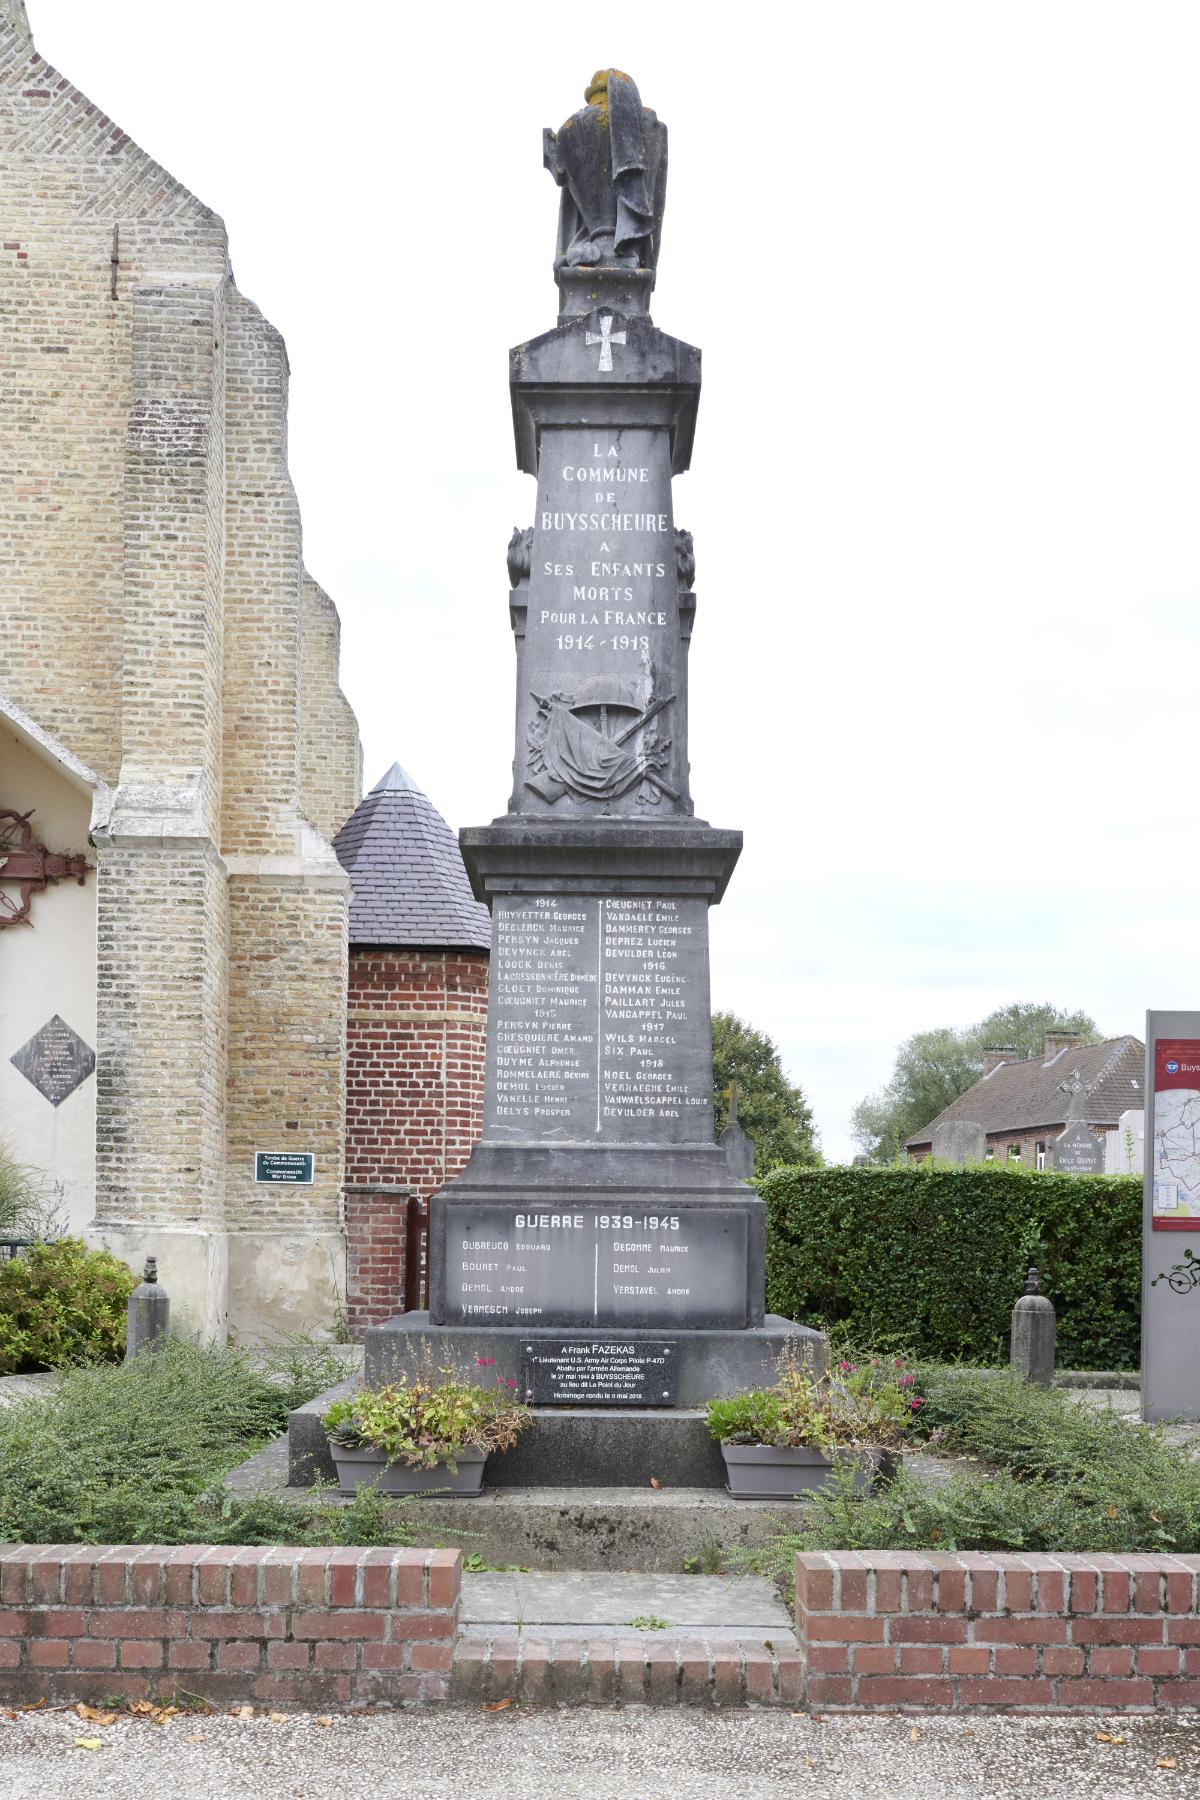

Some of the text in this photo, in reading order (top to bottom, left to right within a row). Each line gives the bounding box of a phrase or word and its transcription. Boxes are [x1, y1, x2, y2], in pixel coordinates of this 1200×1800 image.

[593, 443, 618, 457] LA
[562, 466, 649, 482] COMMUNE
[595, 493, 615, 502] DE
[541, 512, 668, 532] BUYSSCHEURE
[600, 542, 610, 551] A
[544, 562, 665, 577] SES ENFANTS
[573, 586, 633, 601] MORTS
[541, 610, 666, 625] POUR LA FRANCE
[556, 635, 595, 650] 1914
[611, 635, 649, 650] 1918
[535, 899, 557, 907] 1914
[656, 901, 676, 909] PAUL
[554, 912, 587, 920] GEORGES
[606, 912, 653, 921] VANDAELE
[499, 922, 585, 932] DECLERCK MAURICE
[606, 924, 692, 934] DAMMEREY GEORGES
[499, 935, 579, 945] PERSYN JACQUES
[606, 937, 676, 946] DEPREZ LUCIEN
[499, 947, 545, 956] DEVYNCK
[606, 949, 653, 957] DEVULDER
[499, 960, 532, 968] LOOCK
[643, 962, 665, 970] 1916
[606, 973, 651, 982] DEVYNCK
[536, 985, 579, 994] DOMINIQUE
[605, 985, 680, 994] DAMMAN EMILE
[551, 998, 587, 1006] MAURICE
[605, 997, 686, 1007] PAILLART JULES
[534, 1009, 557, 1017] 1915
[605, 1009, 688, 1019] VANCAPPEL PAUL
[498, 1020, 572, 1030] PERSYN PIERRE
[641, 1023, 664, 1031] 1917
[564, 1034, 593, 1042] AMAND
[606, 1034, 634, 1042] WILS
[605, 1045, 653, 1055] SIX PAUL
[497, 1057, 580, 1066] DUYME ALPHONSE
[640, 1059, 663, 1068] 1918
[497, 1069, 560, 1078] ROMMELAERE
[604, 1070, 672, 1080] NOEL GEORGES
[497, 1082, 565, 1091] DEMOL LUCIEN
[605, 1083, 688, 1094] VERHAEGHE EMILE
[497, 1094, 540, 1103] VANELLE
[605, 1096, 682, 1104] VANWAELSCAPPEL
[497, 1106, 570, 1116] DELYS PROSPER
[604, 1107, 654, 1116] DEVULDER
[515, 1215, 680, 1230] GUERRE 1939-1945
[614, 1242, 688, 1253] DEGOMME MAURICE
[462, 1262, 499, 1271] BOURET
[614, 1264, 639, 1273] DEMOL
[462, 1283, 492, 1292] DEMOL
[614, 1285, 658, 1295] VERSTAVEL
[462, 1304, 508, 1314] VERMESCH
[592, 1345, 634, 1354] FAZEKAS
